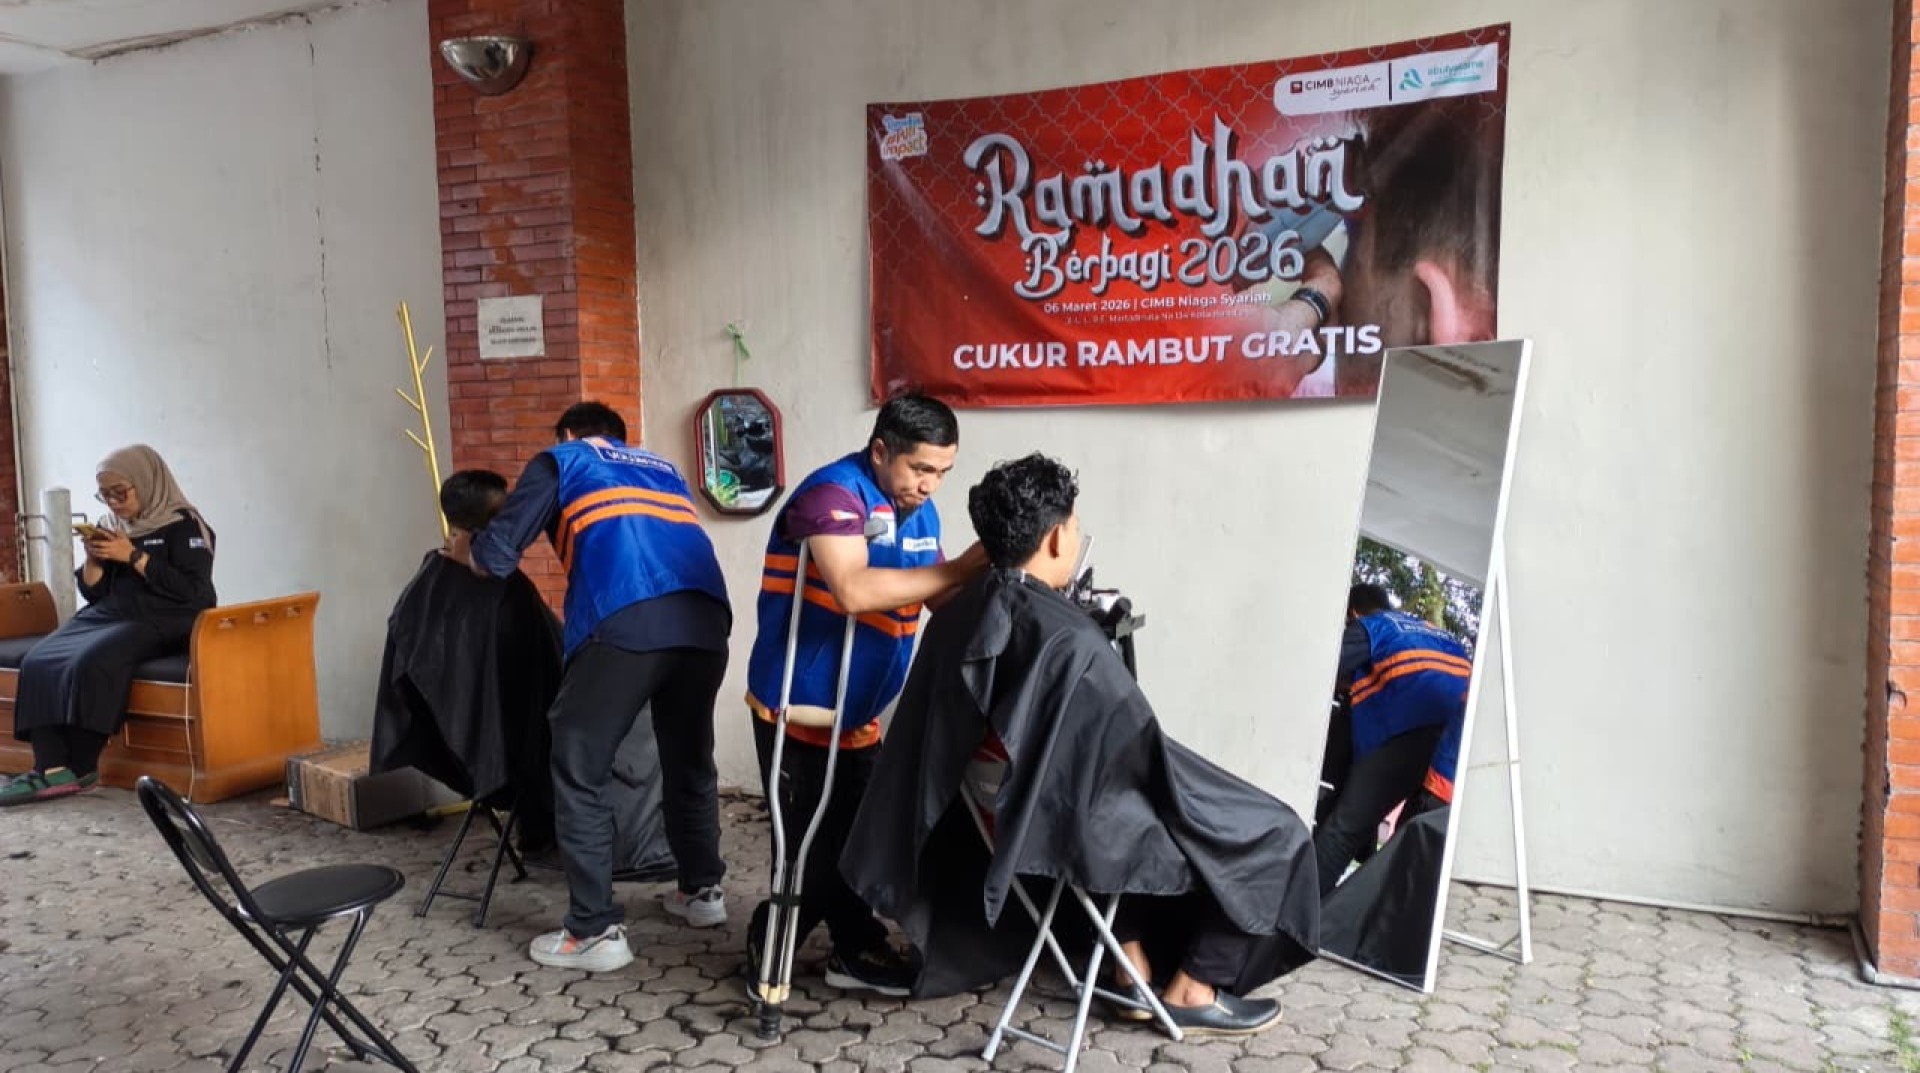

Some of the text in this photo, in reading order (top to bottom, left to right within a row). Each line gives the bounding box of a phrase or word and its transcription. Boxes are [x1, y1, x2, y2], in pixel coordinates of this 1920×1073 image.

[1305, 74, 1370, 90] CIMB NIAGA
[963, 112, 1364, 247] Ramadhan
[1013, 230, 1304, 299] Berbagi 2026
[1043, 302, 1060, 313] 06
[1062, 302, 1097, 313] Maret
[1101, 299, 1131, 310] 2026
[1141, 297, 1175, 308] CIMB
[1178, 295, 1217, 308] Niaga
[1220, 291, 1272, 306] Syariah
[953, 325, 1382, 370] CUKUR RAMBUT GRATIS
